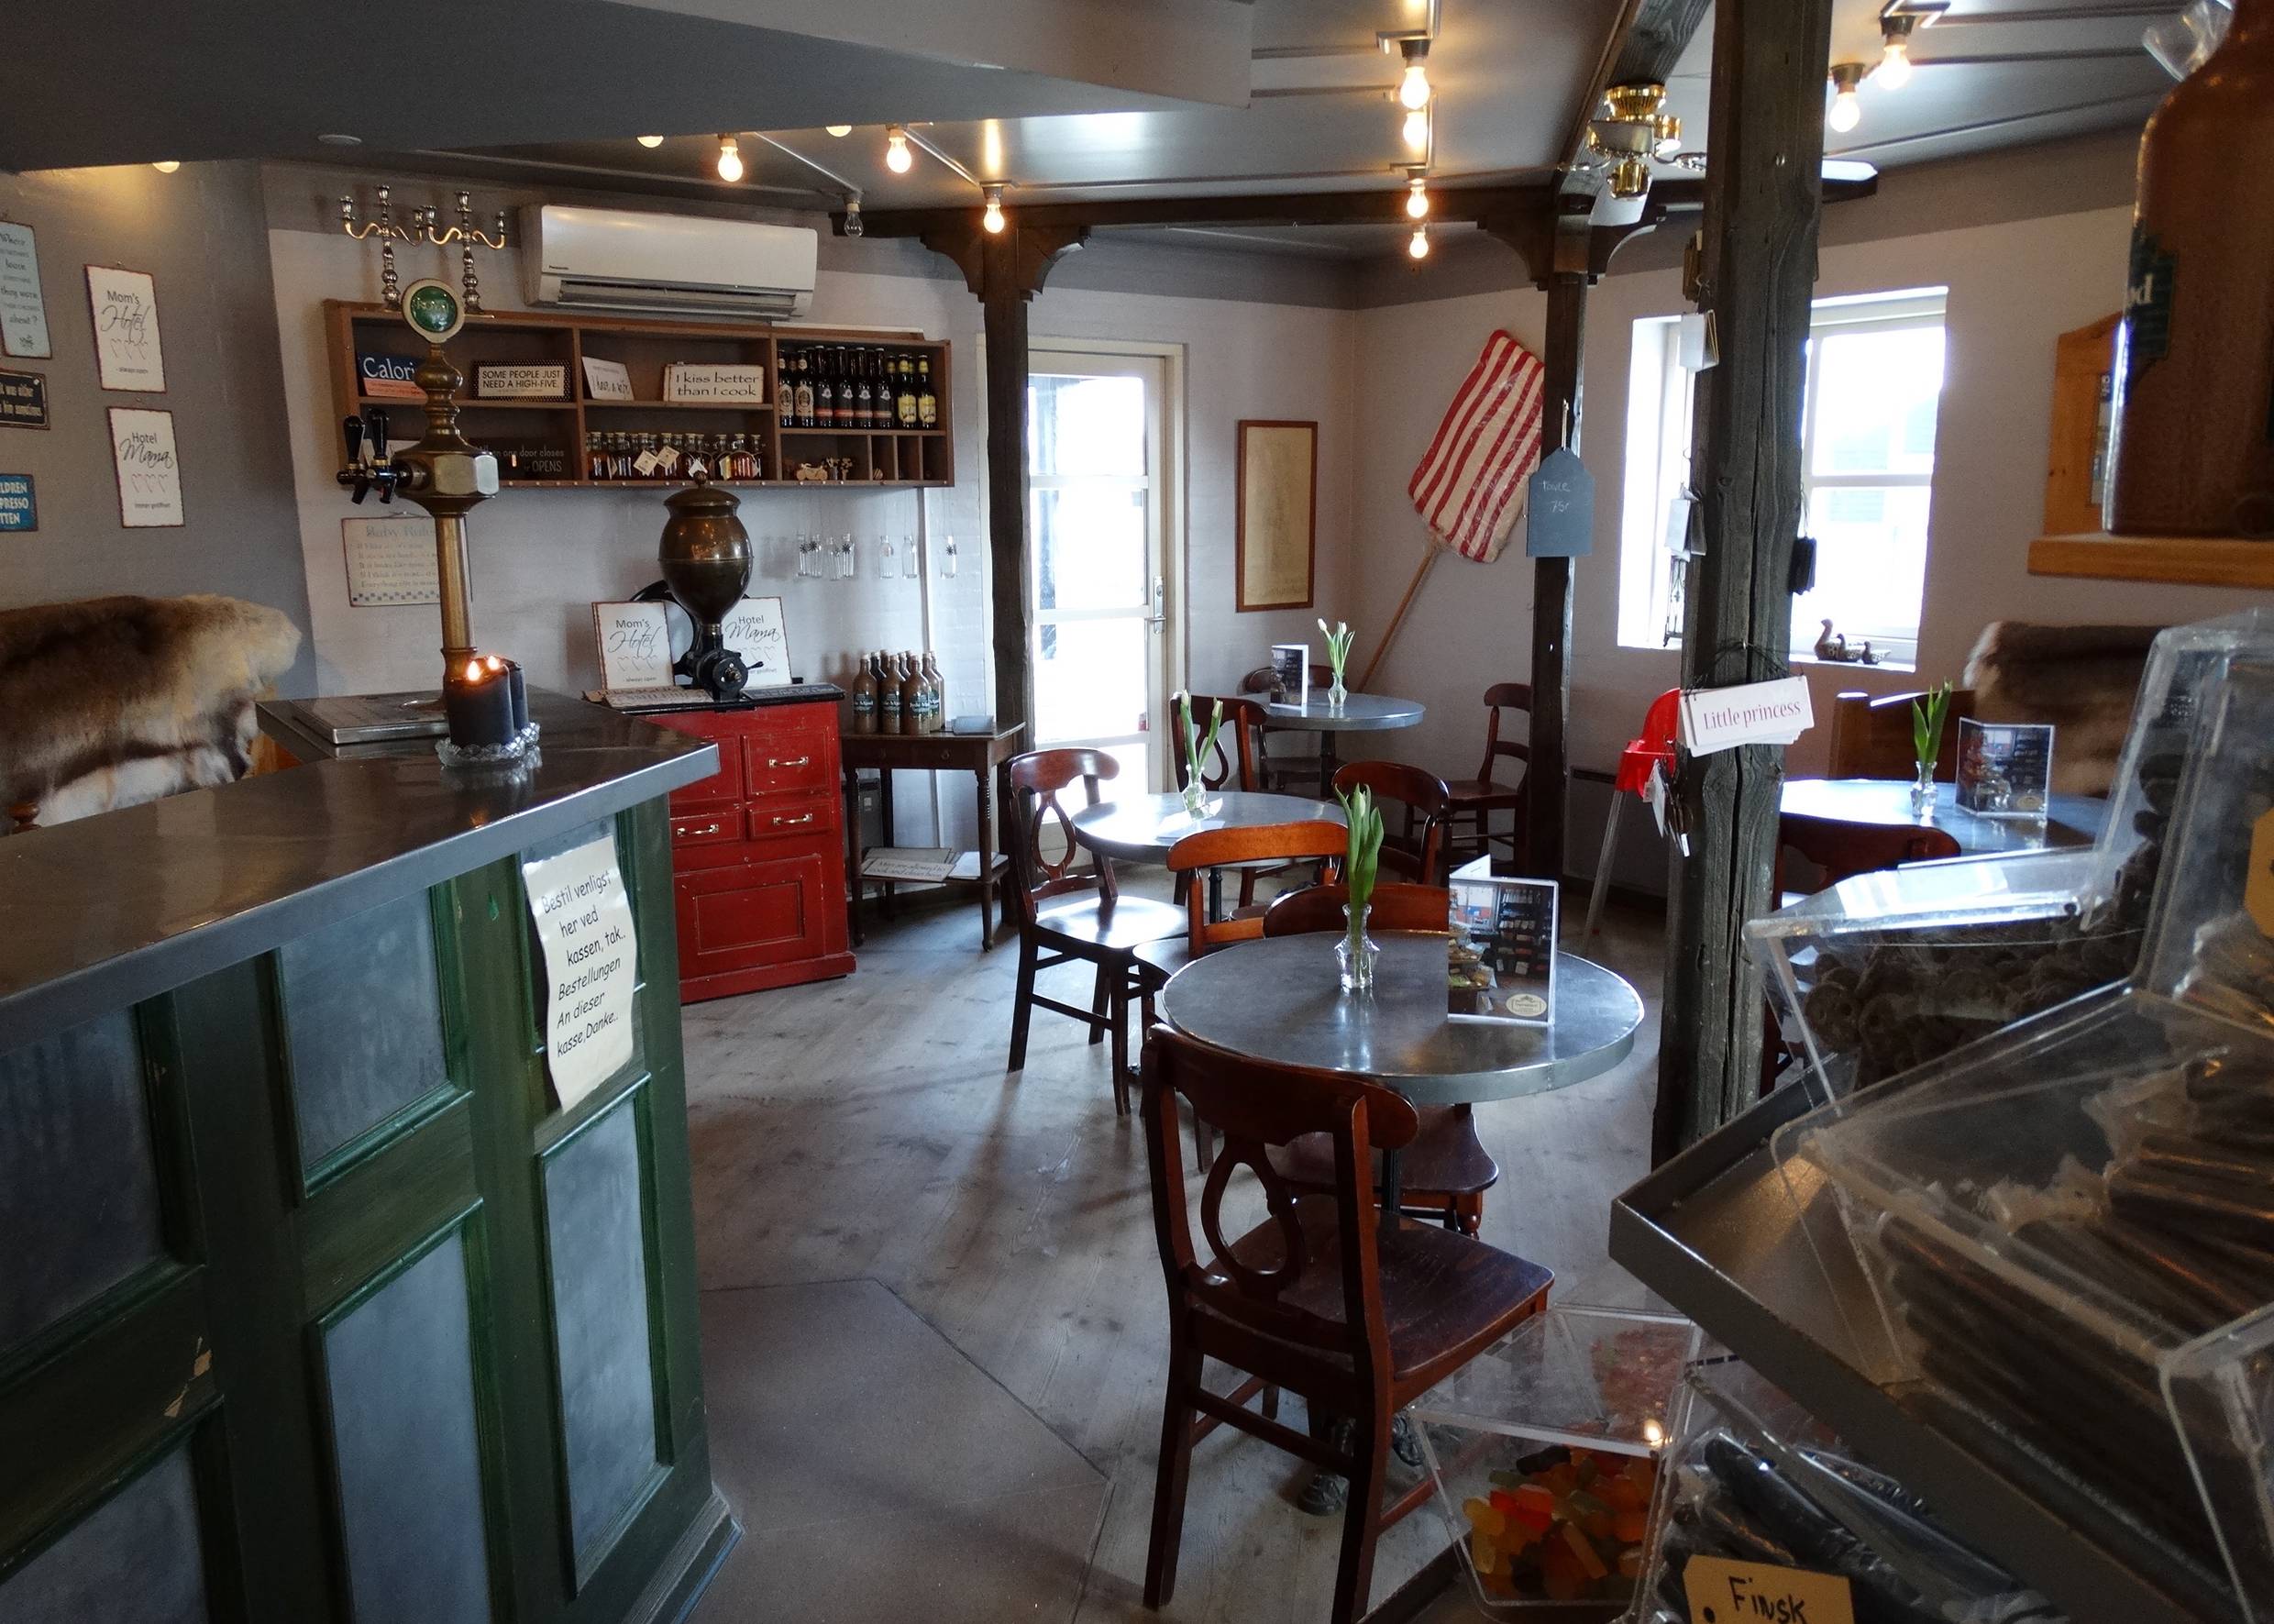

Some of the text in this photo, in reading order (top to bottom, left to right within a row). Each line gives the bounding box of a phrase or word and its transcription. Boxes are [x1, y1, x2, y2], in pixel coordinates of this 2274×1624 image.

[107, 291, 140, 304] Mom's
[101, 304, 151, 347] Hotel
[482, 370, 560, 379] SOME PEOPLE JUST
[676, 371, 759, 383] I kiss better
[482, 380, 505, 388] NEED
[508, 380, 514, 388] A
[678, 384, 756, 396] than I cook
[131, 432, 157, 444] Hotel
[118, 438, 174, 470] Mama
[519, 444, 537, 457] door
[539, 444, 564, 457] closes
[532, 460, 563, 473] OPENS
[615, 619, 650, 628] Mom's
[738, 615, 765, 624] Hotel
[724, 621, 781, 643] Mama
[607, 626, 662, 661] Hotel
[1704, 700, 1803, 730] Little princess
[541, 869, 613, 914] Bestil venligst
[559, 904, 599, 938] her ved
[566, 925, 626, 967] kassen, tak..
[558, 957, 621, 1000] Bestellungen
[557, 991, 605, 1029] An dieser
